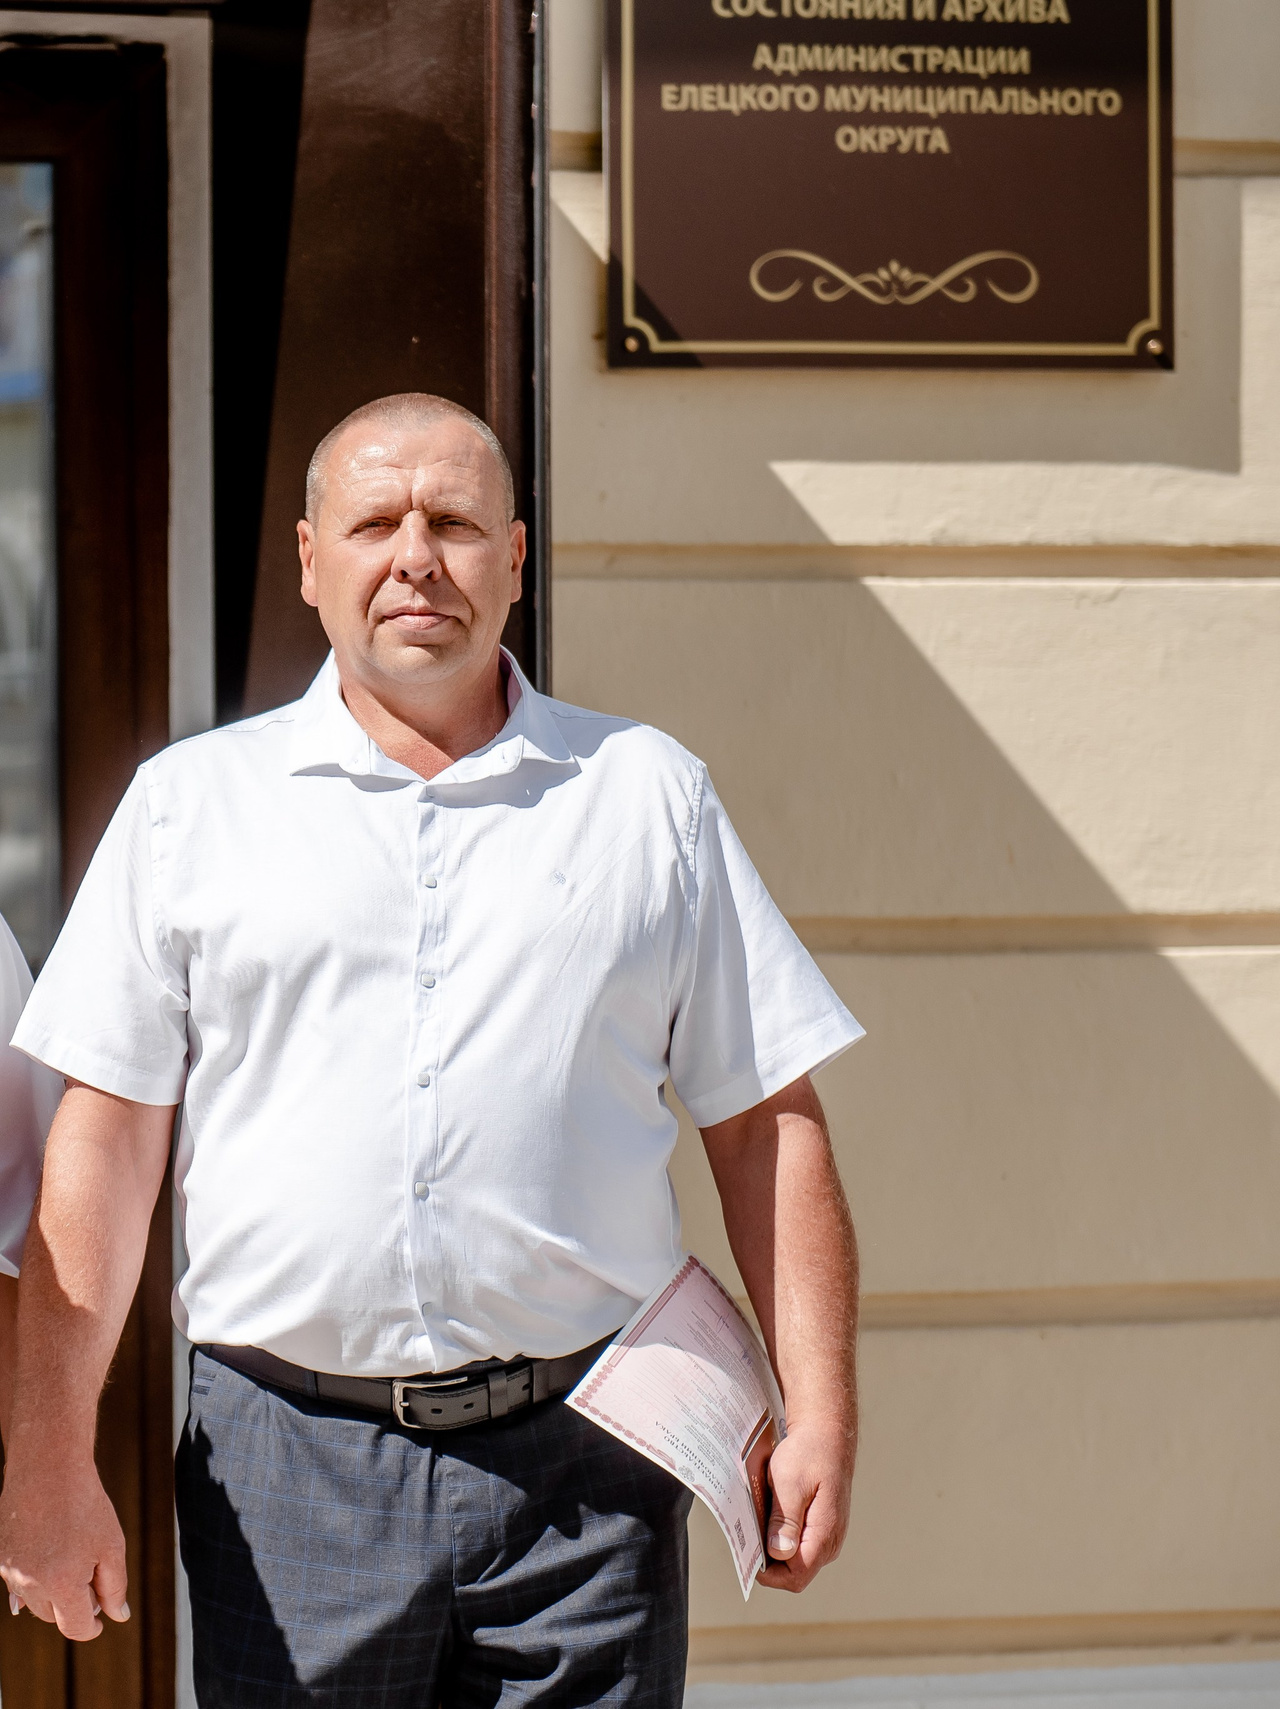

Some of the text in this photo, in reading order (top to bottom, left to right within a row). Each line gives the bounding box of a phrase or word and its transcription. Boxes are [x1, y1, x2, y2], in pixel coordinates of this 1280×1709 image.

[712, 0, 1070, 24] СОСТОЯНИЯ И АРХИВА
[752, 43, 1031, 78] АДМИНИСТРАЦИИ
[661, 84, 1121, 118] ЕЛЕЦКОГО МУНИЦИПАЛЬНОГО
[835, 125, 951, 154] ОКРУГА
